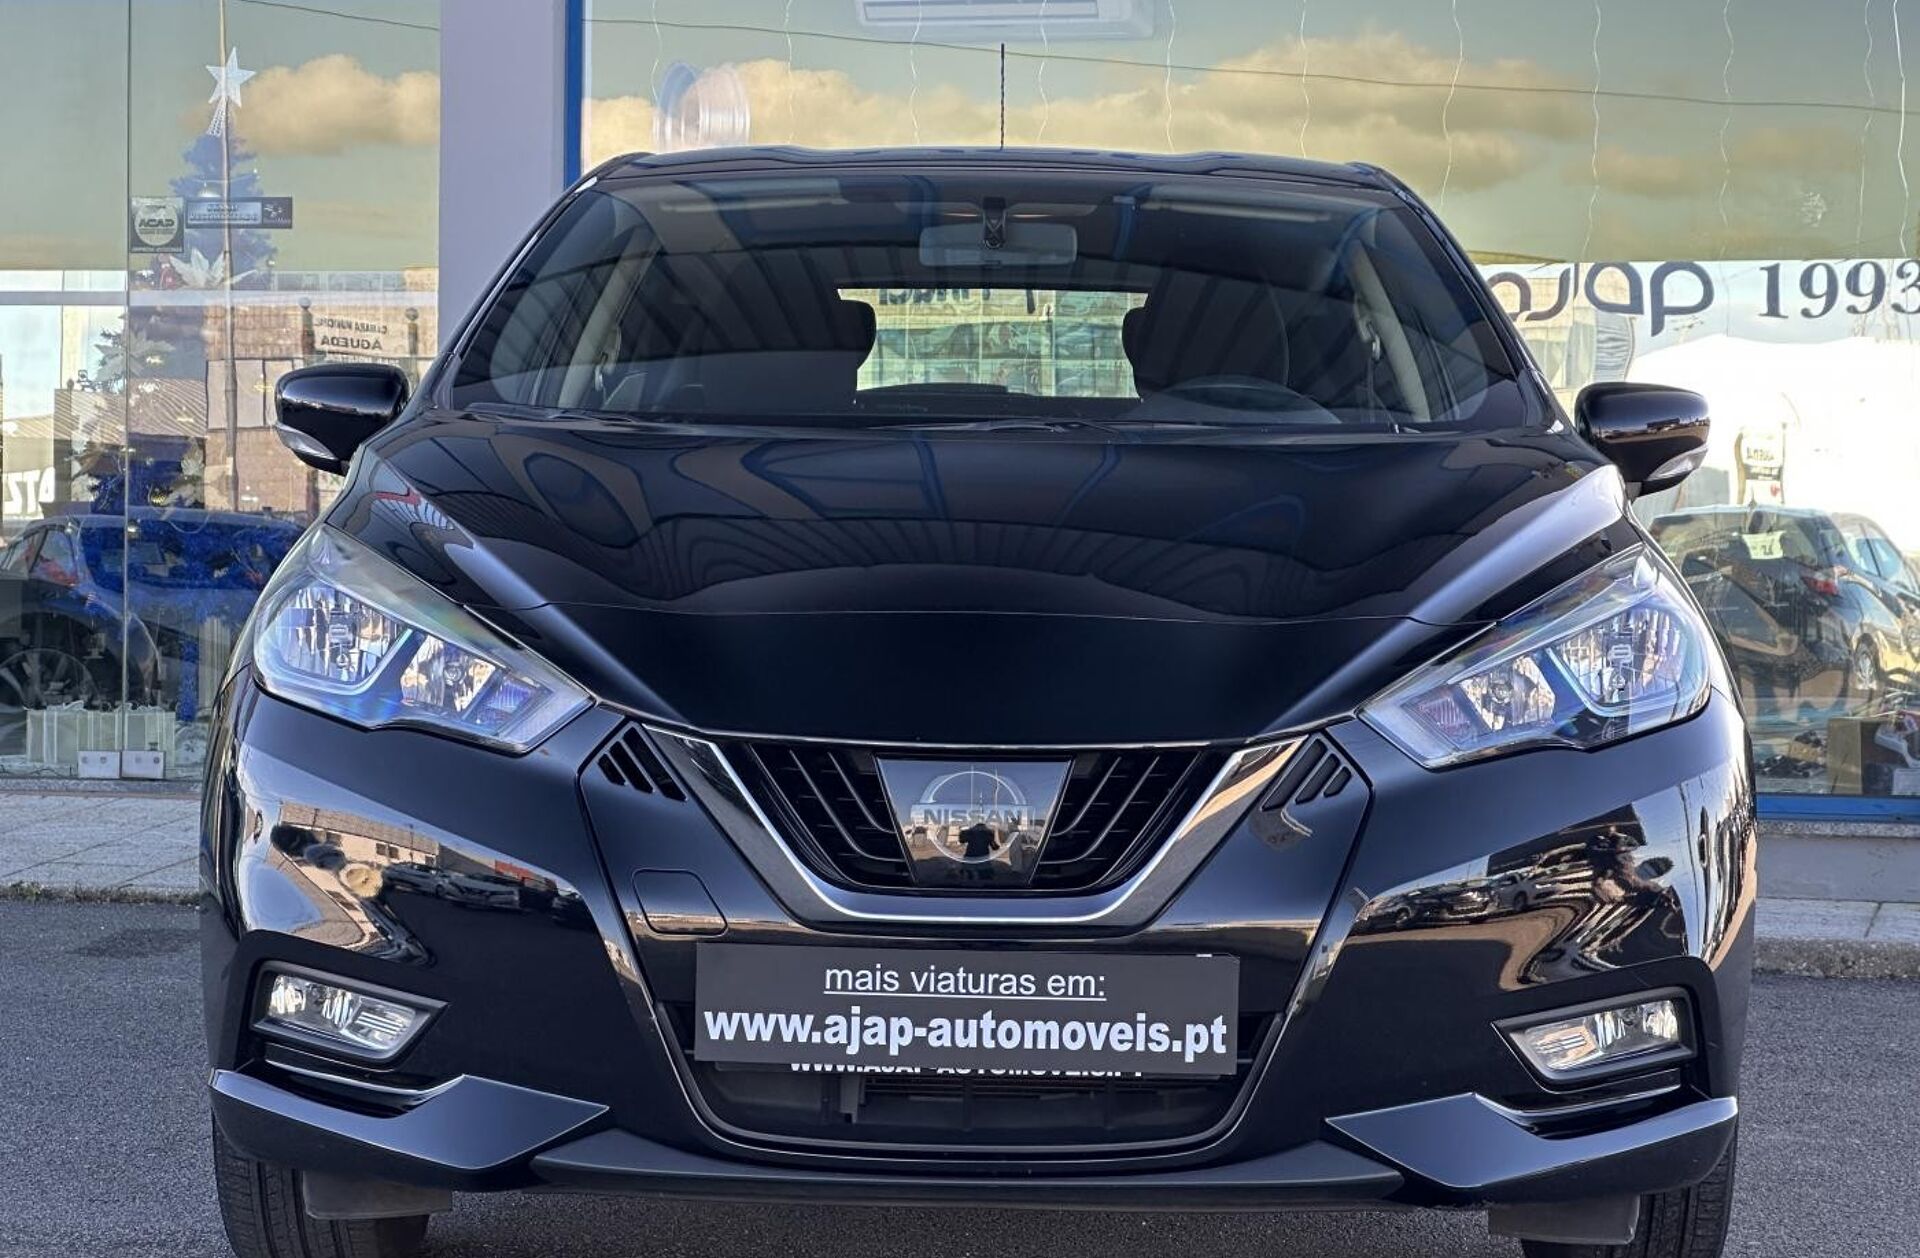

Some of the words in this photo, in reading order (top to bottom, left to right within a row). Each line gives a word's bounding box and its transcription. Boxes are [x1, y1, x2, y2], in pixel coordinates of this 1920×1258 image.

[1758, 260, 1920, 319] 1993
[923, 808, 1021, 825] NISSAN
[825, 963, 900, 991] mais
[910, 965, 1036, 995] viaturas
[1047, 974, 1105, 996] em:
[703, 1005, 1227, 1063] www.ajap-automoveis.pt
